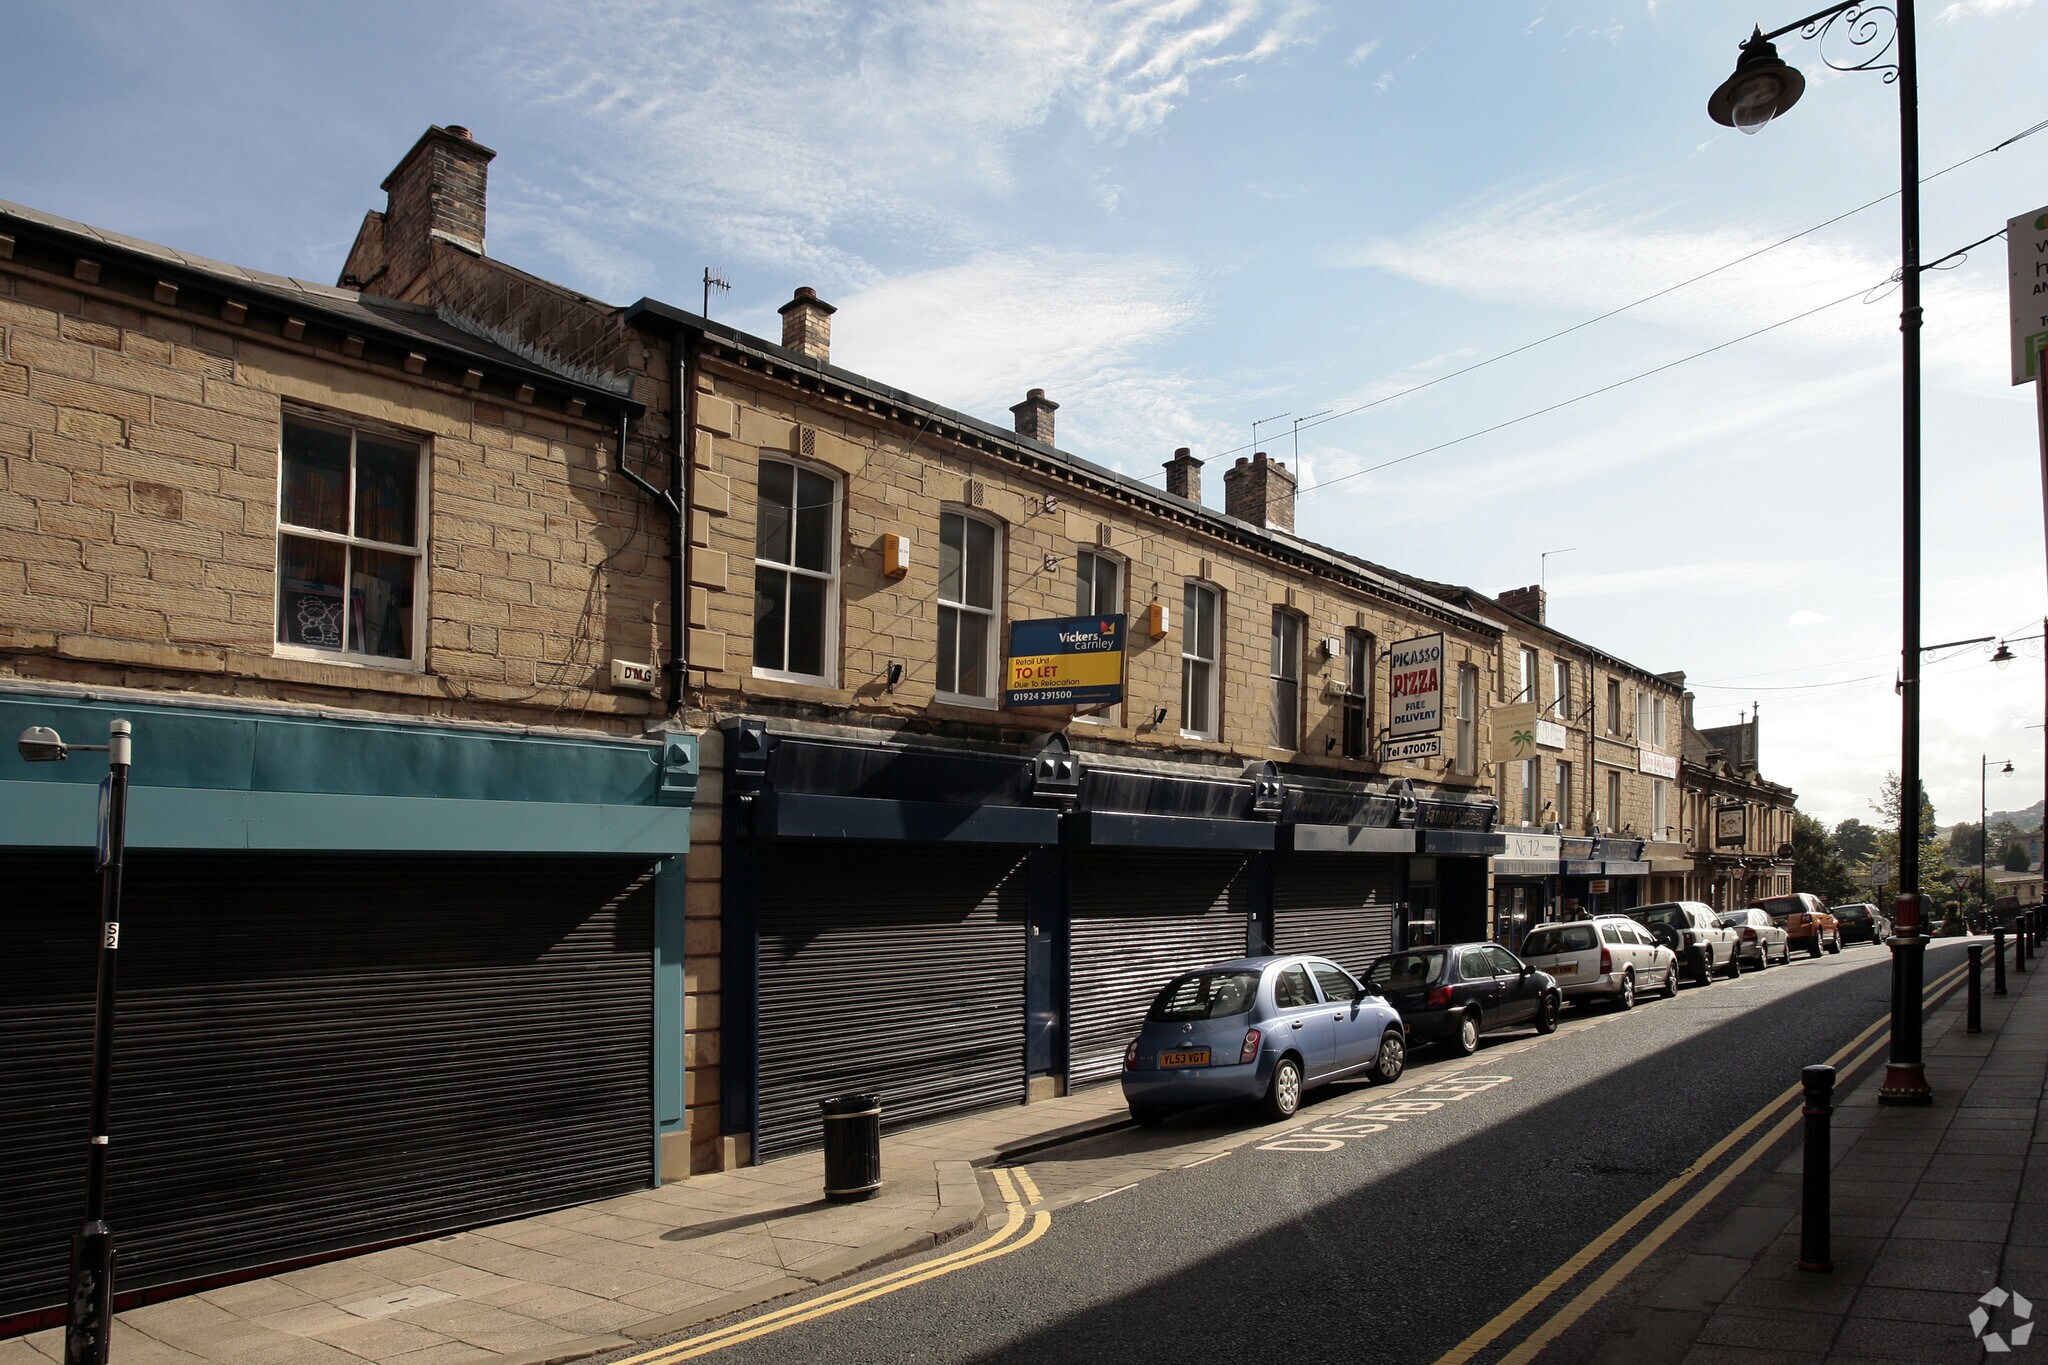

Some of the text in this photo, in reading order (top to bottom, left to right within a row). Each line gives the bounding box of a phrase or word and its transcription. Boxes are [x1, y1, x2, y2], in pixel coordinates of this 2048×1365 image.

[1059, 631, 1098, 643] Vickers
[1074, 638, 1114, 651] carnley
[1015, 657, 1050, 666] Retail Unit
[1392, 646, 1440, 668] PICASSO
[1015, 666, 1058, 679] TO LET
[1014, 678, 1080, 689] Due To Relocation
[1393, 668, 1438, 698] PIZZA
[1013, 692, 1039, 702] 01924
[1041, 690, 1072, 700] 291500
[1405, 700, 1426, 711] FREE
[1394, 709, 1437, 724] DELIVERY
[1388, 742, 1437, 758] Tel 470075
[1164, 1052, 1205, 1065] YL53 VGT
[1255, 1075, 1513, 1152] DISABLED
